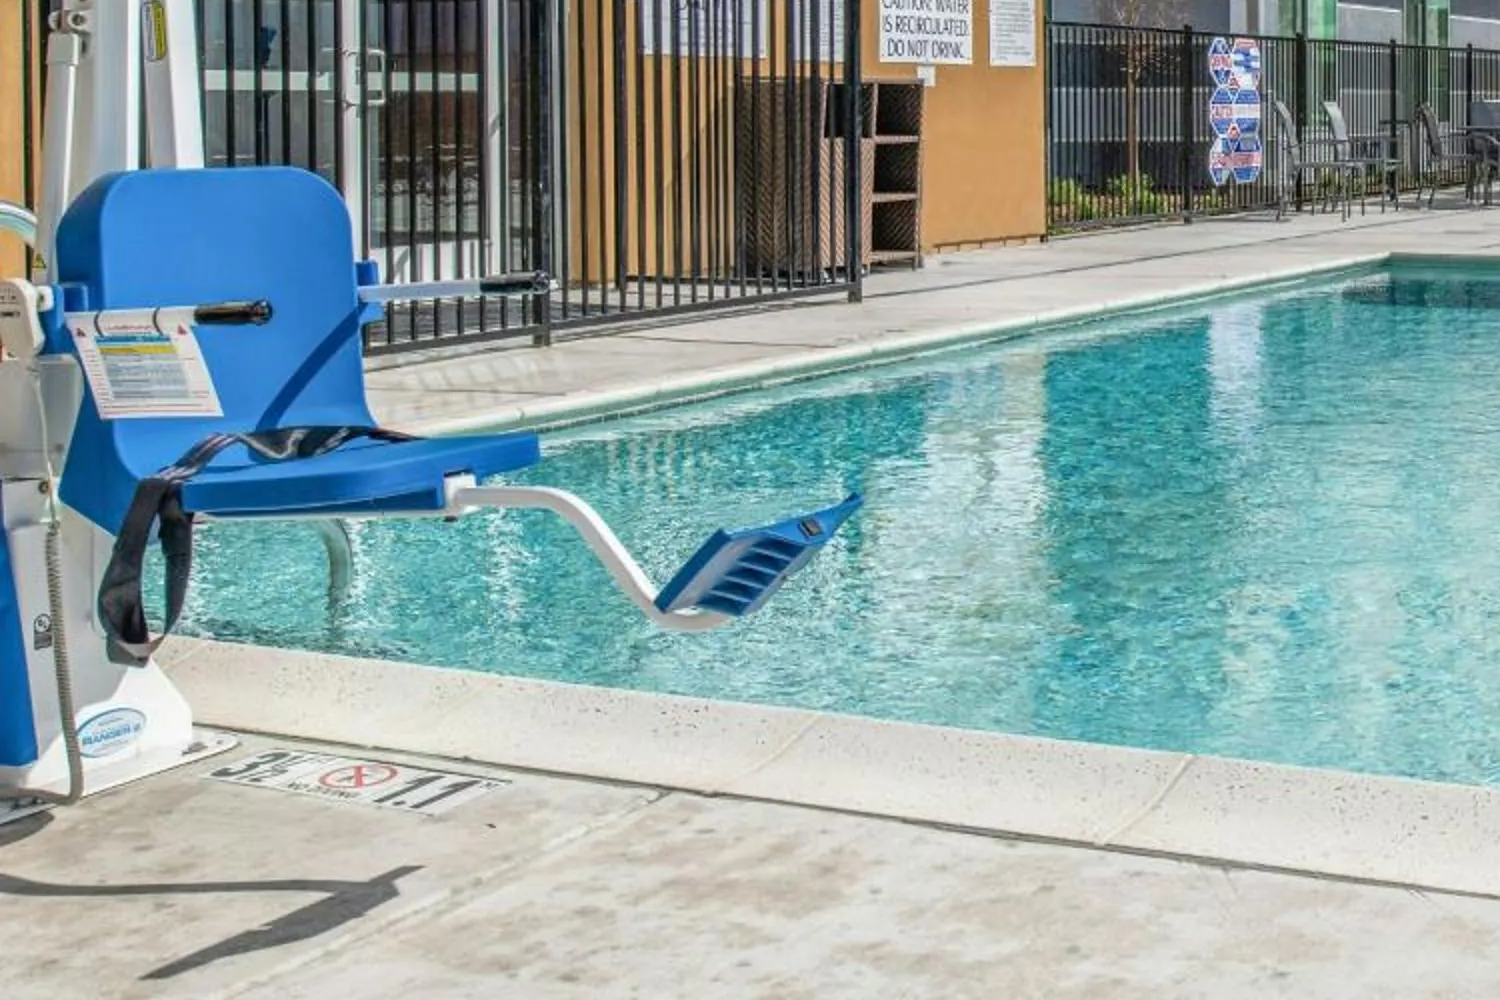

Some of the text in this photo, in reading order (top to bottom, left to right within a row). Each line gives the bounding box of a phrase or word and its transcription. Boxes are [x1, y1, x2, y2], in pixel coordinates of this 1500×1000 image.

[883, 15, 893, 33] IS
[887, 38, 905, 57] DO
[907, 39, 929, 58] NOT
